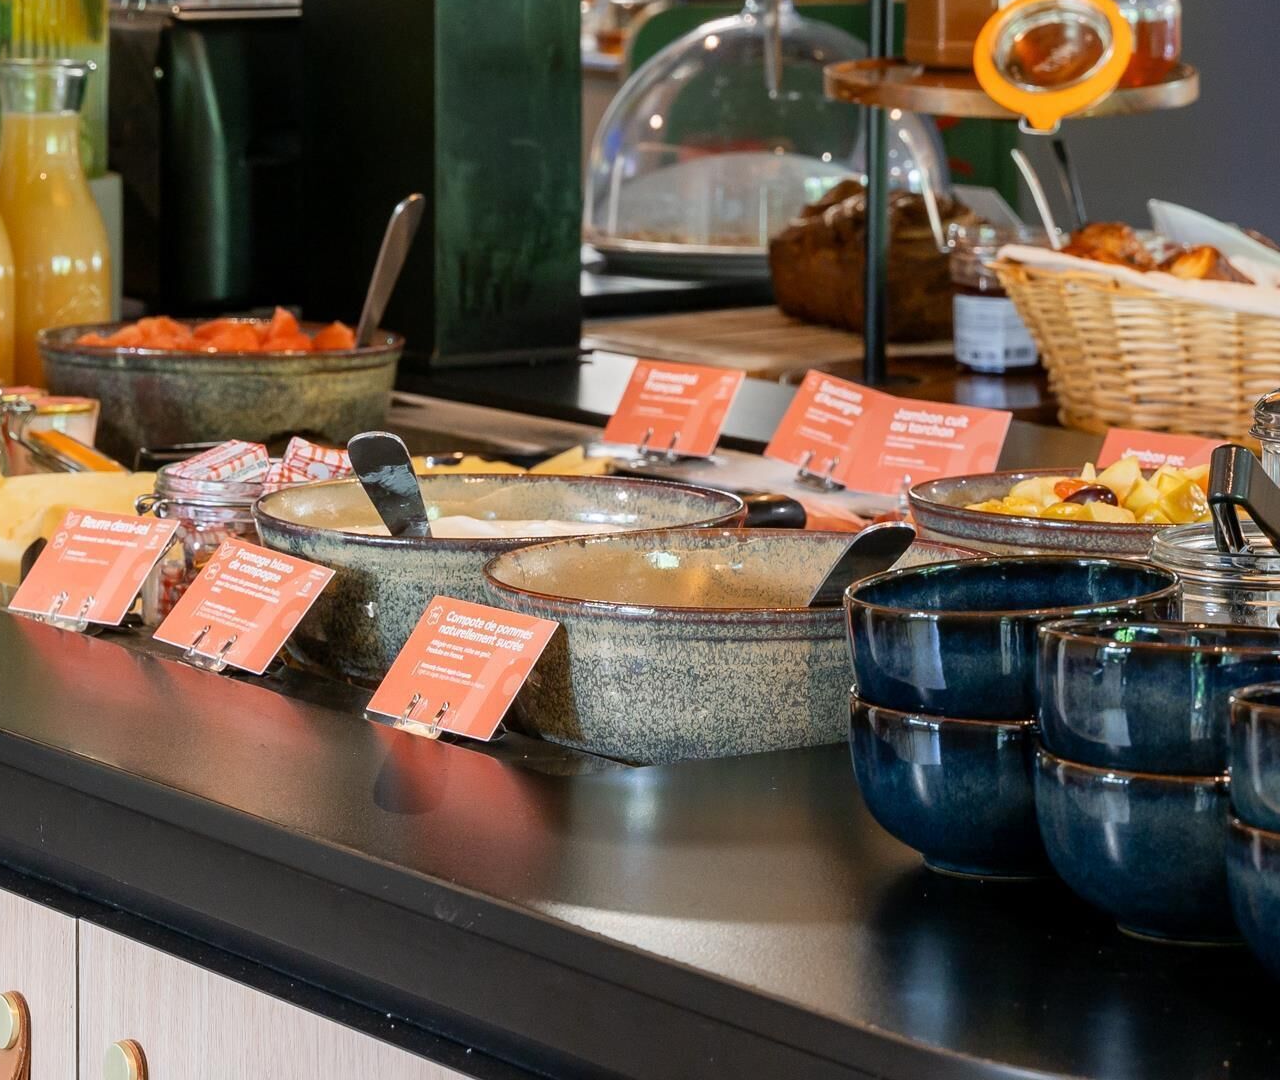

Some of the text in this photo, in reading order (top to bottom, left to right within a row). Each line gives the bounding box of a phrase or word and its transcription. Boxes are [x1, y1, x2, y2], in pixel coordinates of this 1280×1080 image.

[890, 421, 956, 438] au torchon
[894, 408, 969, 429] Jambon cuit
[80, 515, 112, 531] Beurre
[110, 519, 152, 535] demi-sel
[228, 559, 282, 583] de campagne
[236, 548, 295, 574] Fromage blanc
[446, 611, 535, 640] Compote de pommes
[438, 624, 525, 652] naturellement sucrée
